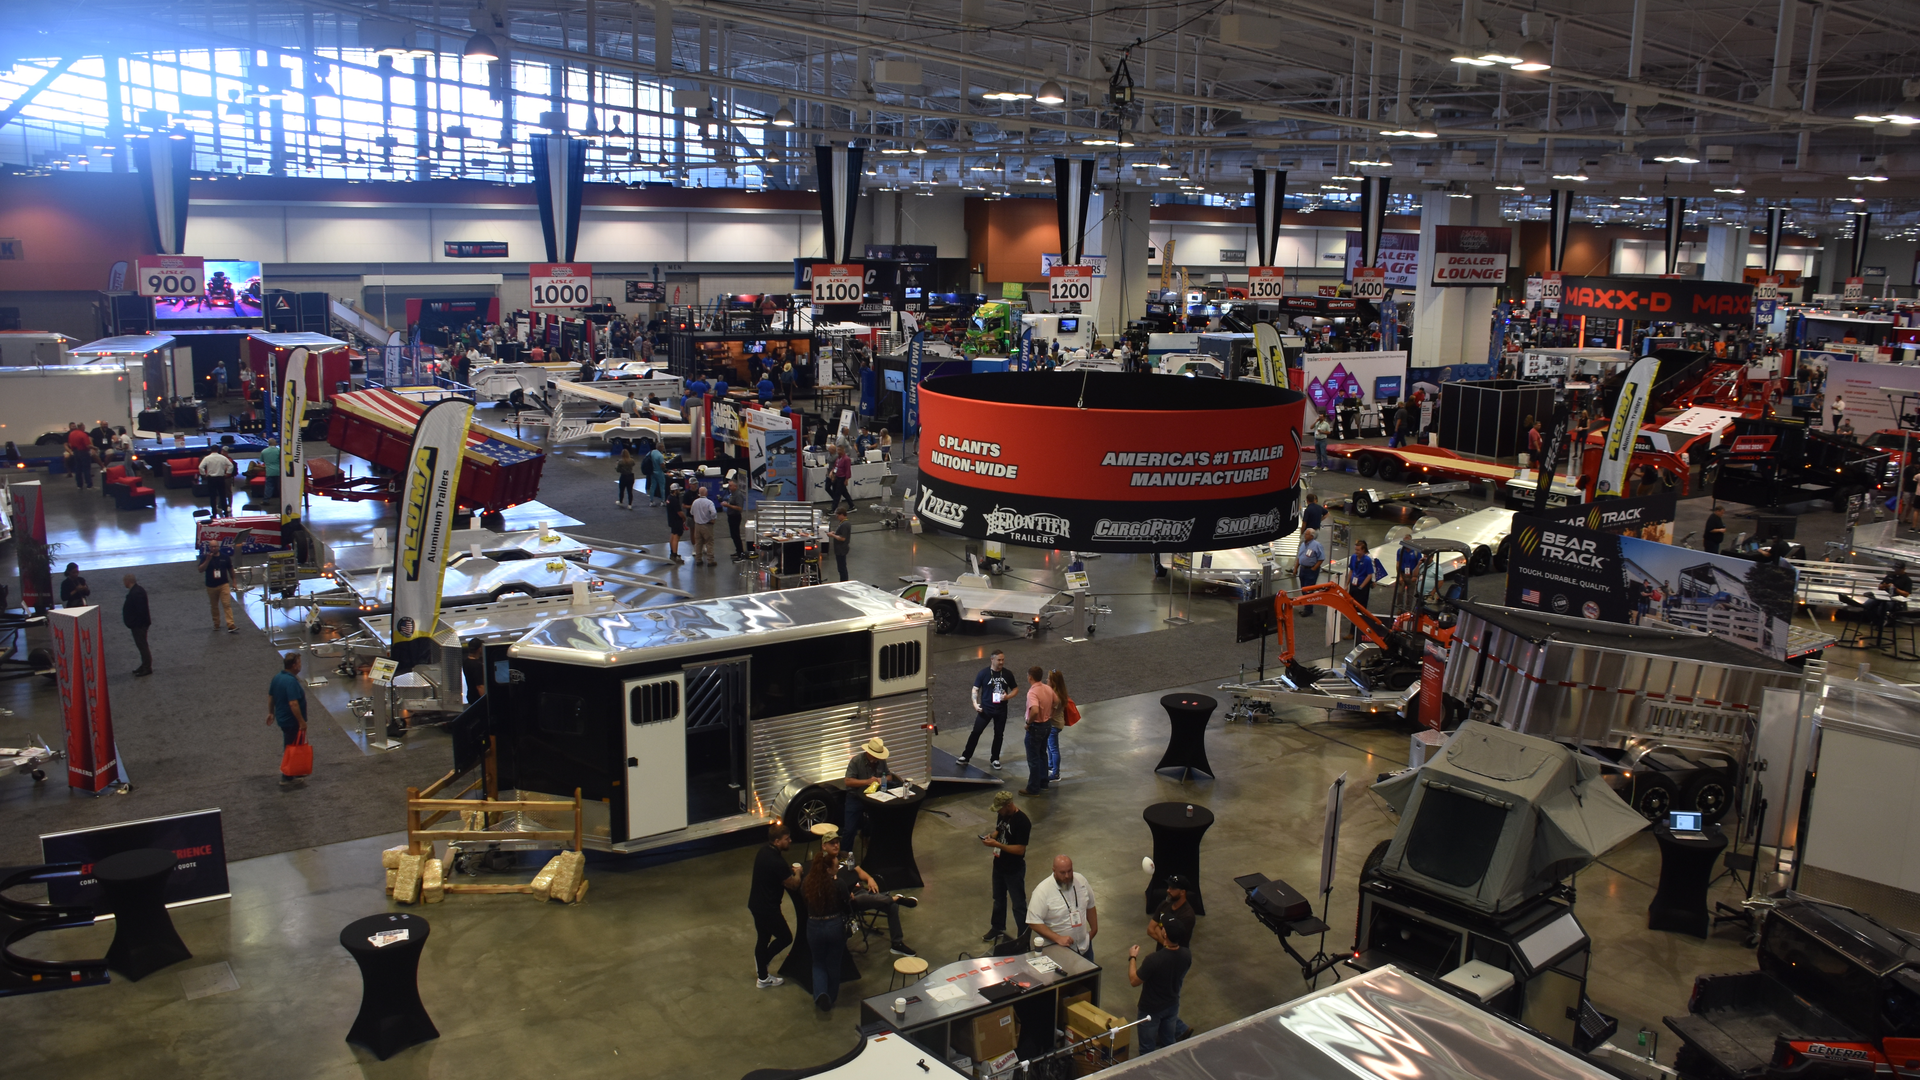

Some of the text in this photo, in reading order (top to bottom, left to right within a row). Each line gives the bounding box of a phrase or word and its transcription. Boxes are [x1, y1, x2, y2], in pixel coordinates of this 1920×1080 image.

[1448, 256, 1495, 266] DEALER
[148, 275, 197, 293] 900
[1437, 268, 1504, 280] LOUNGE
[534, 284, 589, 304] 1000
[815, 283, 860, 301] 1100
[1052, 283, 1090, 299] 1200
[1250, 282, 1282, 297] 1300
[1353, 282, 1382, 296] 1400
[1565, 286, 1672, 312] MAXX-D
[1759, 287, 1777, 298] 1700
[905, 303, 916, 311] KEEP
[1757, 314, 1773, 323] 1649
[1021, 338, 1029, 361] OWN
[908, 341, 920, 404] RENT TO OWN
[284, 380, 296, 477] ALUMA
[1608, 382, 1635, 458] ALUMA
[1621, 397, 1643, 451] Aluminum Trailers
[938, 434, 1001, 458] 6 PLANTS
[1100, 444, 1285, 467] AMERICA'S #1 TRAILER
[931, 450, 1018, 479] NATION-WIDE
[1130, 466, 1270, 487] MANUFACTURER
[403, 447, 432, 578] ALUMA
[917, 484, 968, 522] XPRESS
[427, 469, 450, 563] Aluminum Trailers
[995, 510, 1071, 538] FRONTIER
[1215, 512, 1274, 535] SNOPRO
[1601, 508, 1642, 524] TRACK
[1010, 532, 1055, 544] TRAILERS
[1095, 518, 1184, 538] CARGOPRO
[1541, 531, 1597, 553] BEAR
[1540, 545, 1605, 569] TRACK
[1518, 566, 1611, 593] TOUGH. DURABLE. QUALITY.
[177, 862, 197, 870] QUOTE
[1806, 1045, 1869, 1060] GENERAL
